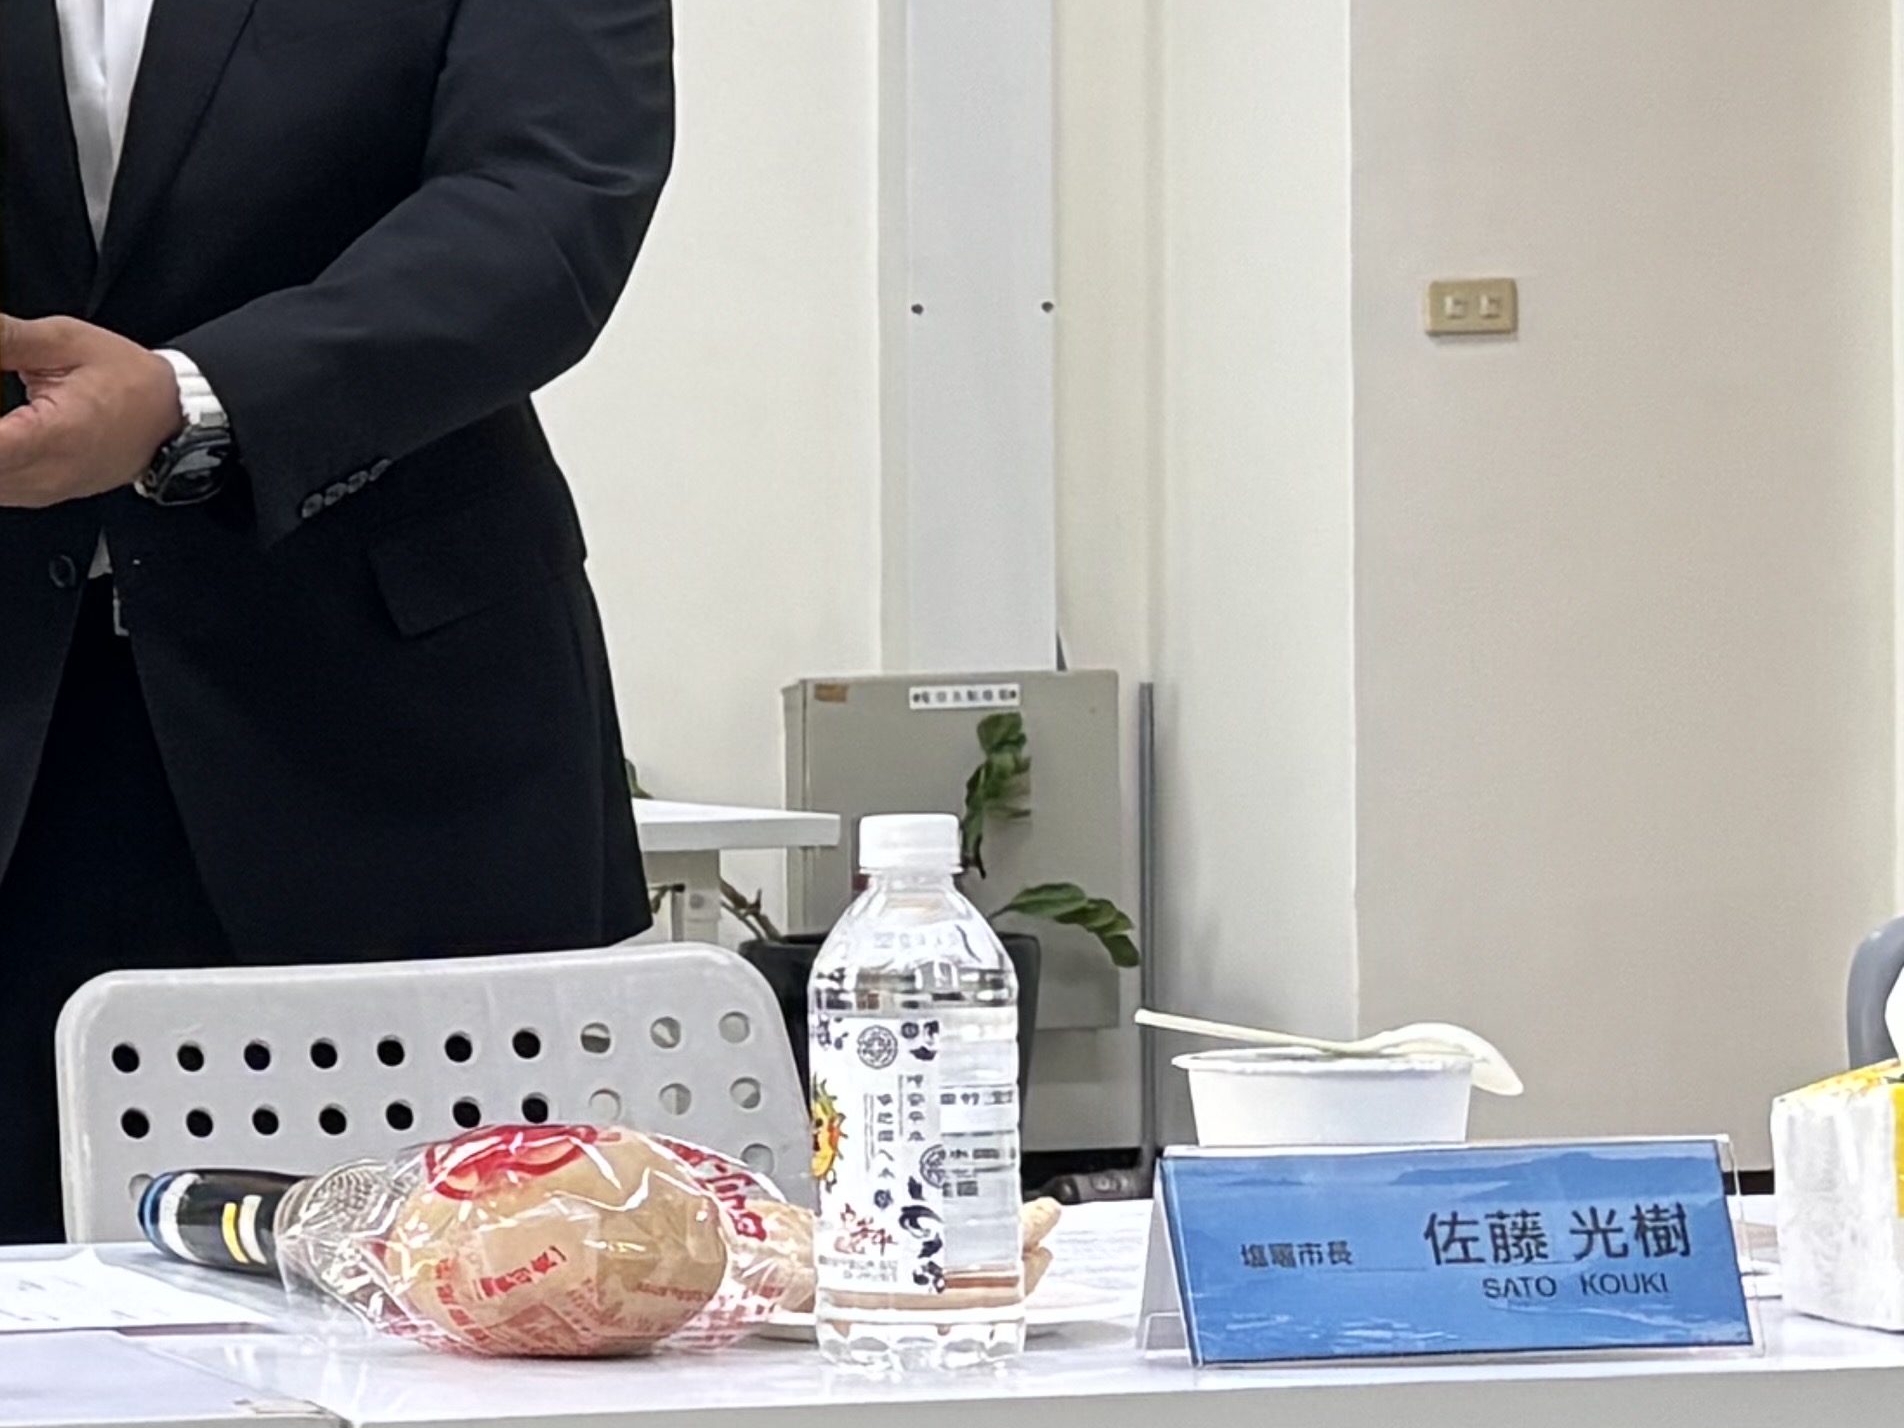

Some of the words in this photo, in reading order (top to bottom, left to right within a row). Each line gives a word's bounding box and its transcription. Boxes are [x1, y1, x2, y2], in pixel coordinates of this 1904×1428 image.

[1424, 1210, 1549, 1266] 佐藤
[1569, 1201, 1691, 1260] 光樹
[1482, 1274, 1558, 1299] SATO
[1579, 1271, 1670, 1296] KOUKI
